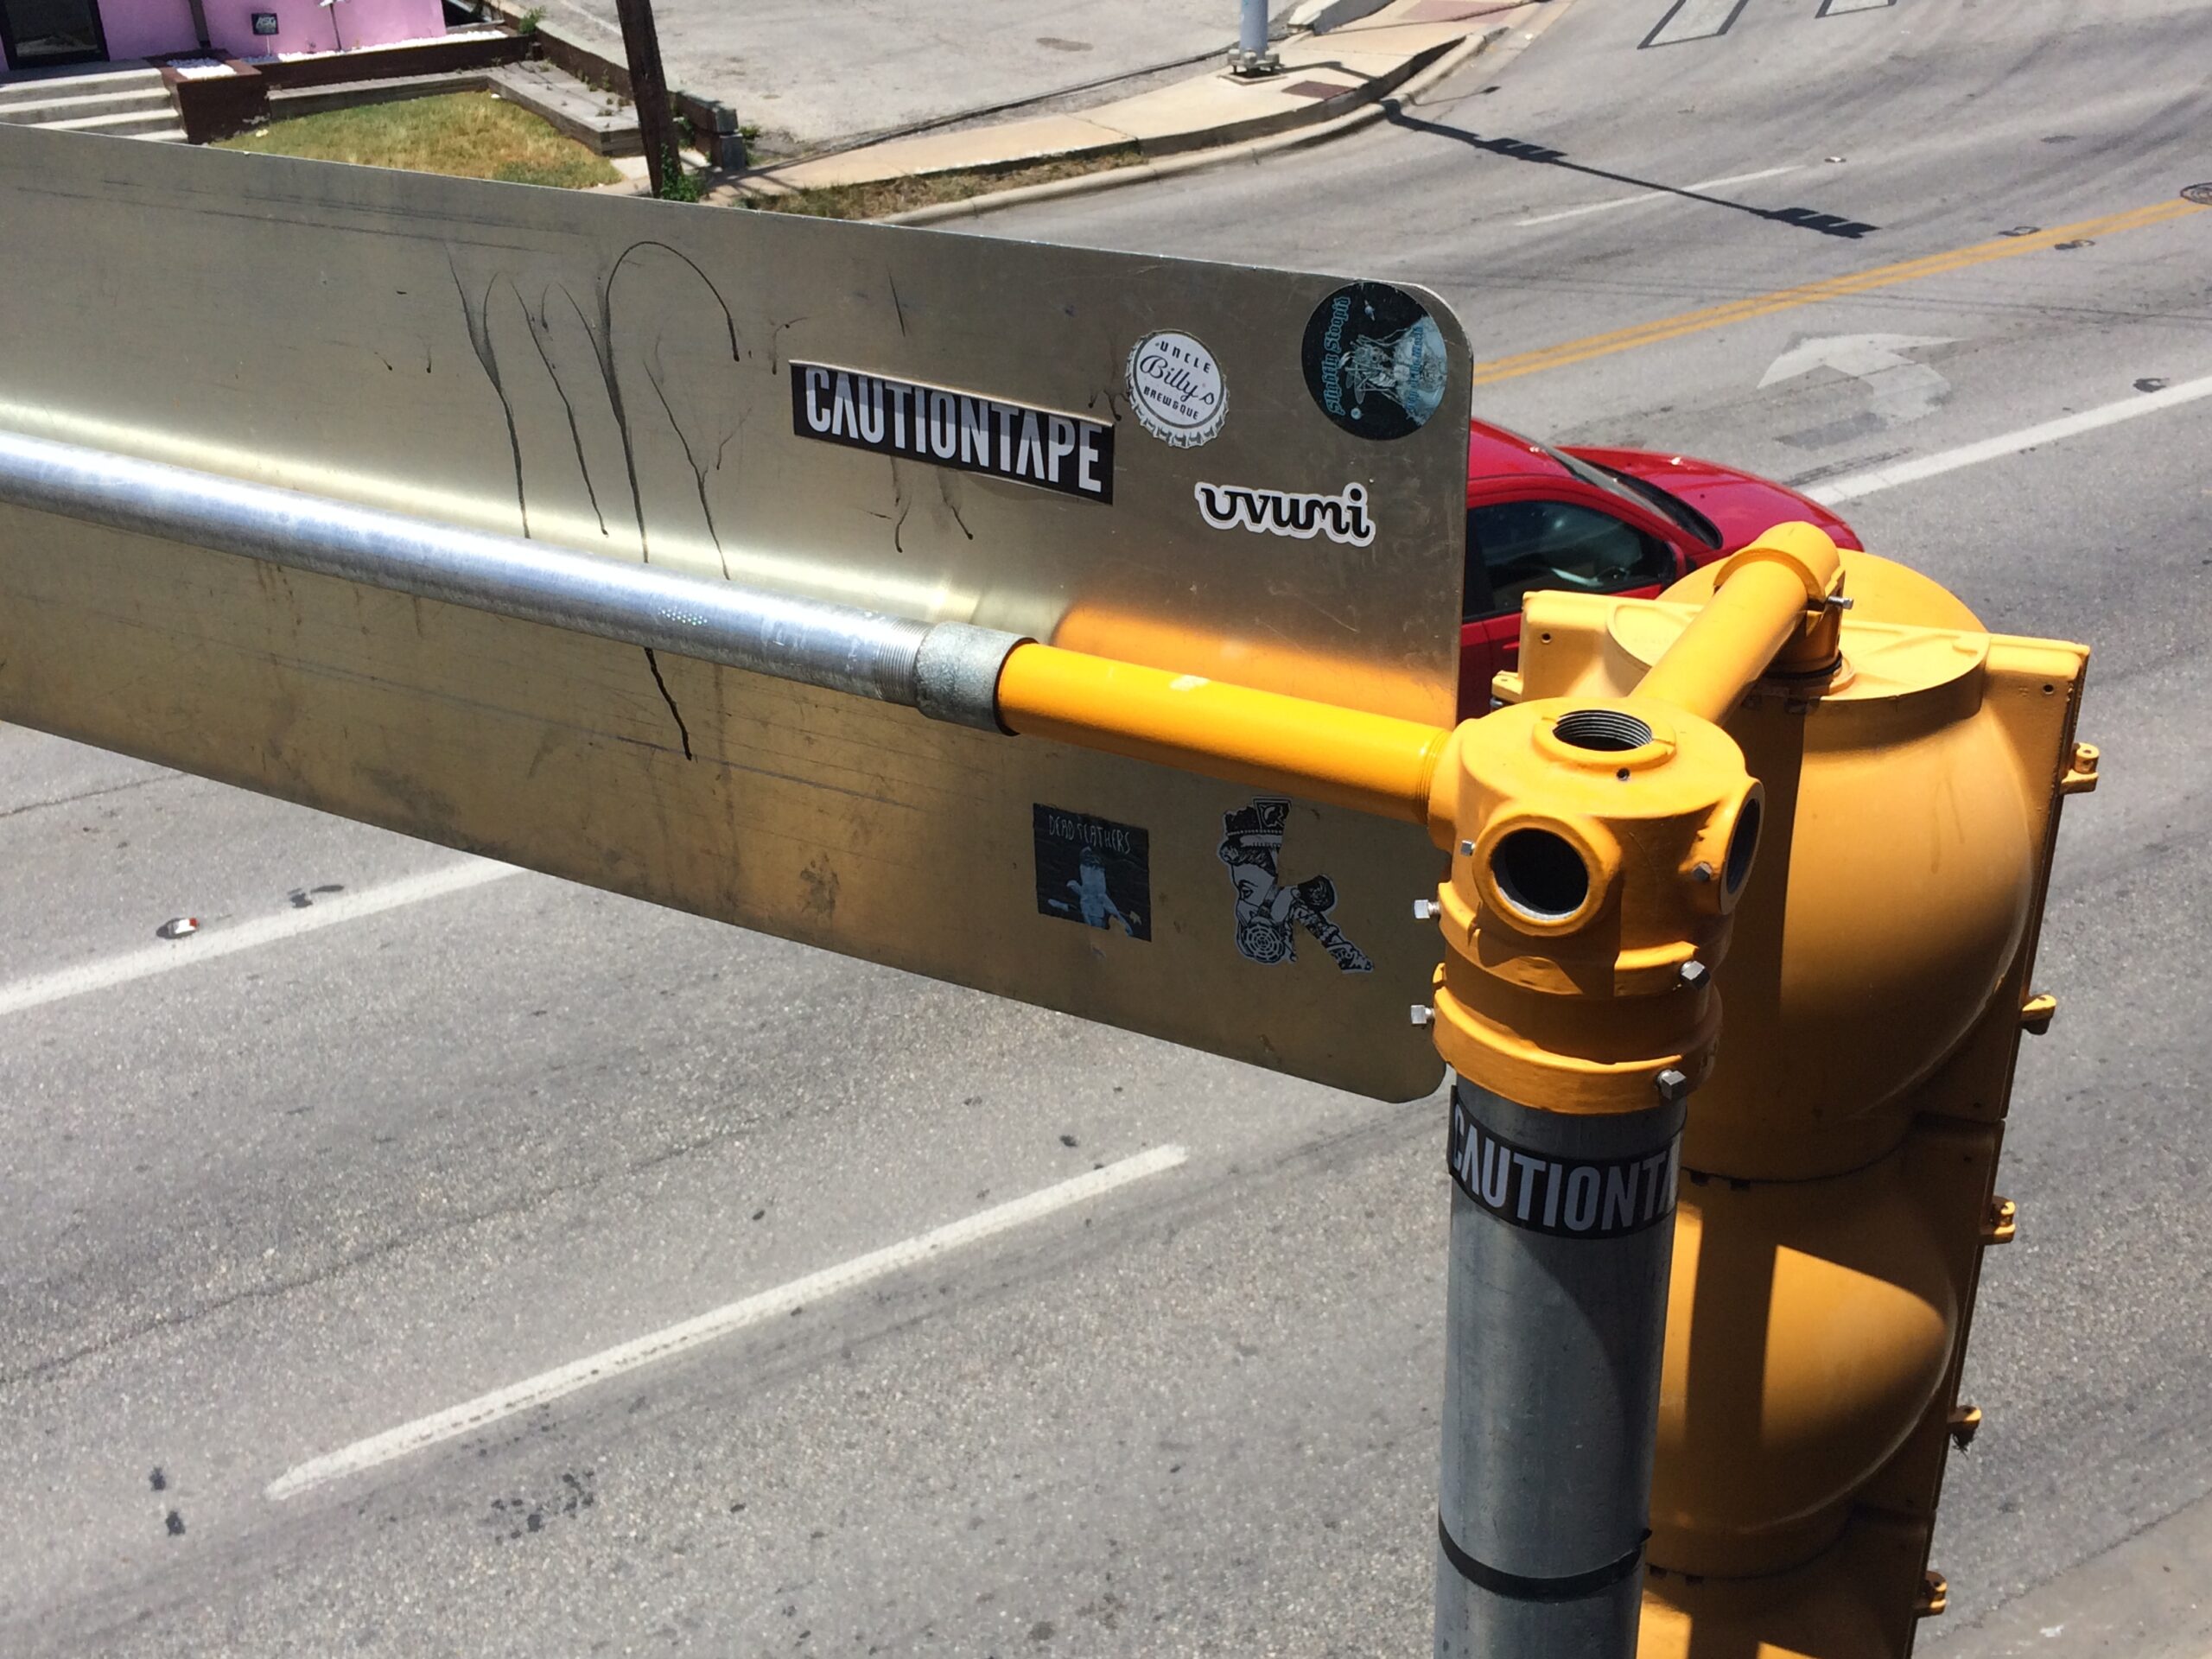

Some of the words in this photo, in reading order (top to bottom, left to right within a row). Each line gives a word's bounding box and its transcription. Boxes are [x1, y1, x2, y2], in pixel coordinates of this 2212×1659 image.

[1324, 296, 1351, 352] Stoopid
[1160, 340, 1211, 374] UNCLE
[1143, 385, 1199, 420] BREW&QUE
[1322, 355, 1345, 416] Slightly
[805, 366, 1103, 493] CAUTIONTAPE
[1048, 815, 1074, 841] DEAD
[1077, 823, 1130, 855] FEATHERS
